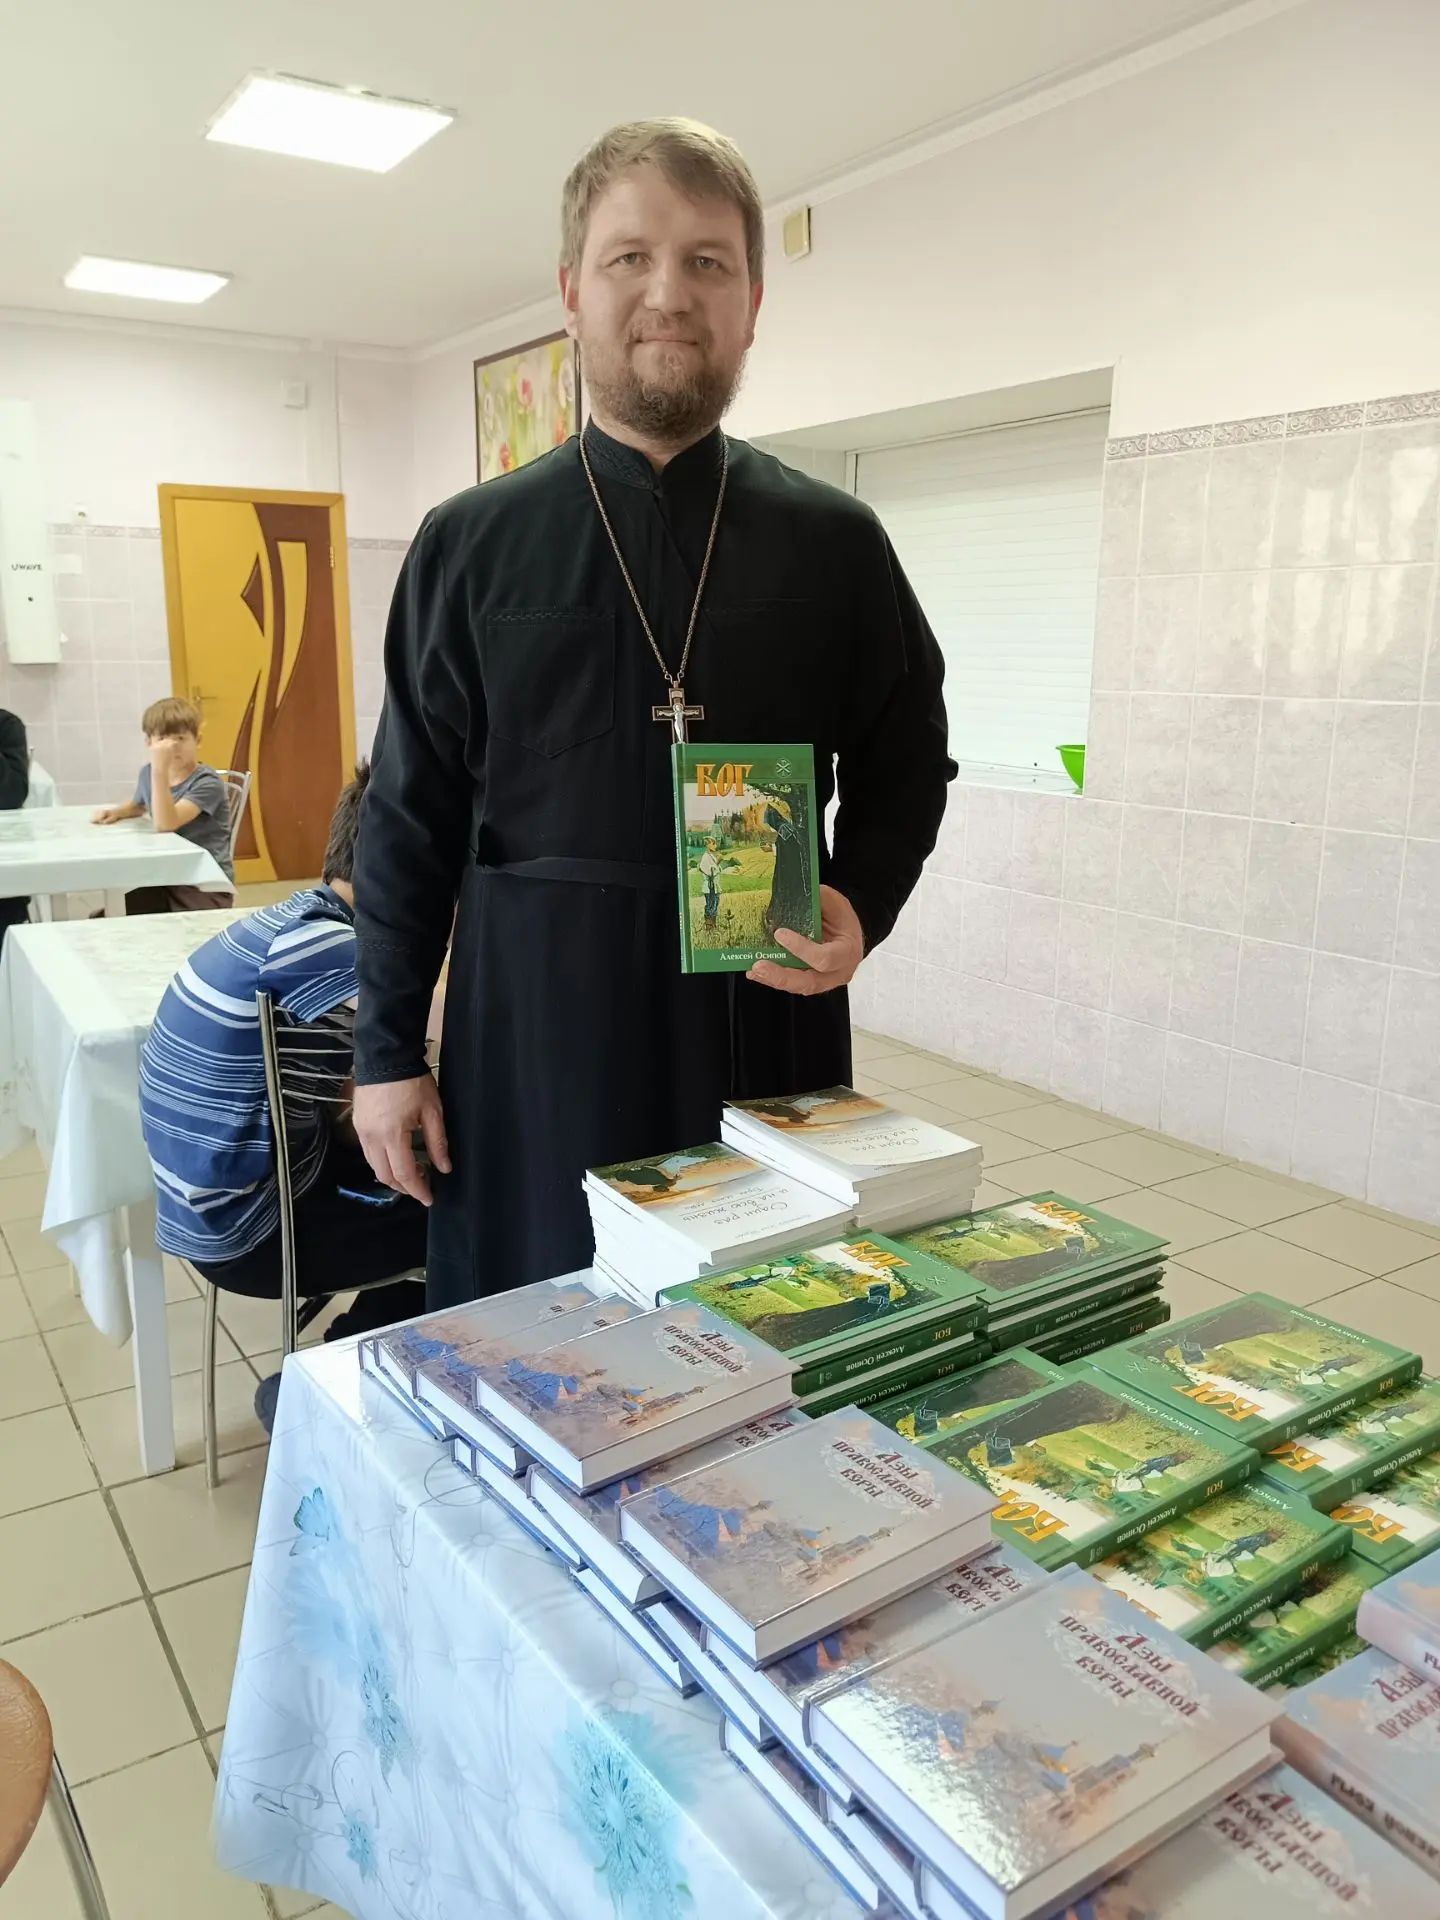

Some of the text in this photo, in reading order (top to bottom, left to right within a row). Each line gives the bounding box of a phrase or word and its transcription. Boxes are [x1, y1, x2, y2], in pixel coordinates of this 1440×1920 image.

[695, 762, 753, 797] БОГ
[719, 951, 786, 961] Алексей Осипов
[730, 1199, 757, 1210] всю
[760, 1193, 775, 1201] на
[682, 1206, 726, 1222] жизнь
[714, 1201, 788, 1225] Один раз
[1030, 1201, 1097, 1225] БОГ
[838, 1240, 912, 1269] БОГ
[931, 1327, 952, 1341] БОГ
[845, 1345, 905, 1372] Алексей Осипов
[1378, 1377, 1394, 1392] БОГ
[1120, 1392, 1204, 1436] Алексей Осипов
[1171, 1381, 1265, 1423] БОГ
[1204, 1479, 1224, 1498] БОГ
[1243, 1483, 1293, 1511] Алексей
[1116, 1506, 1178, 1544] Алексей Осипов
